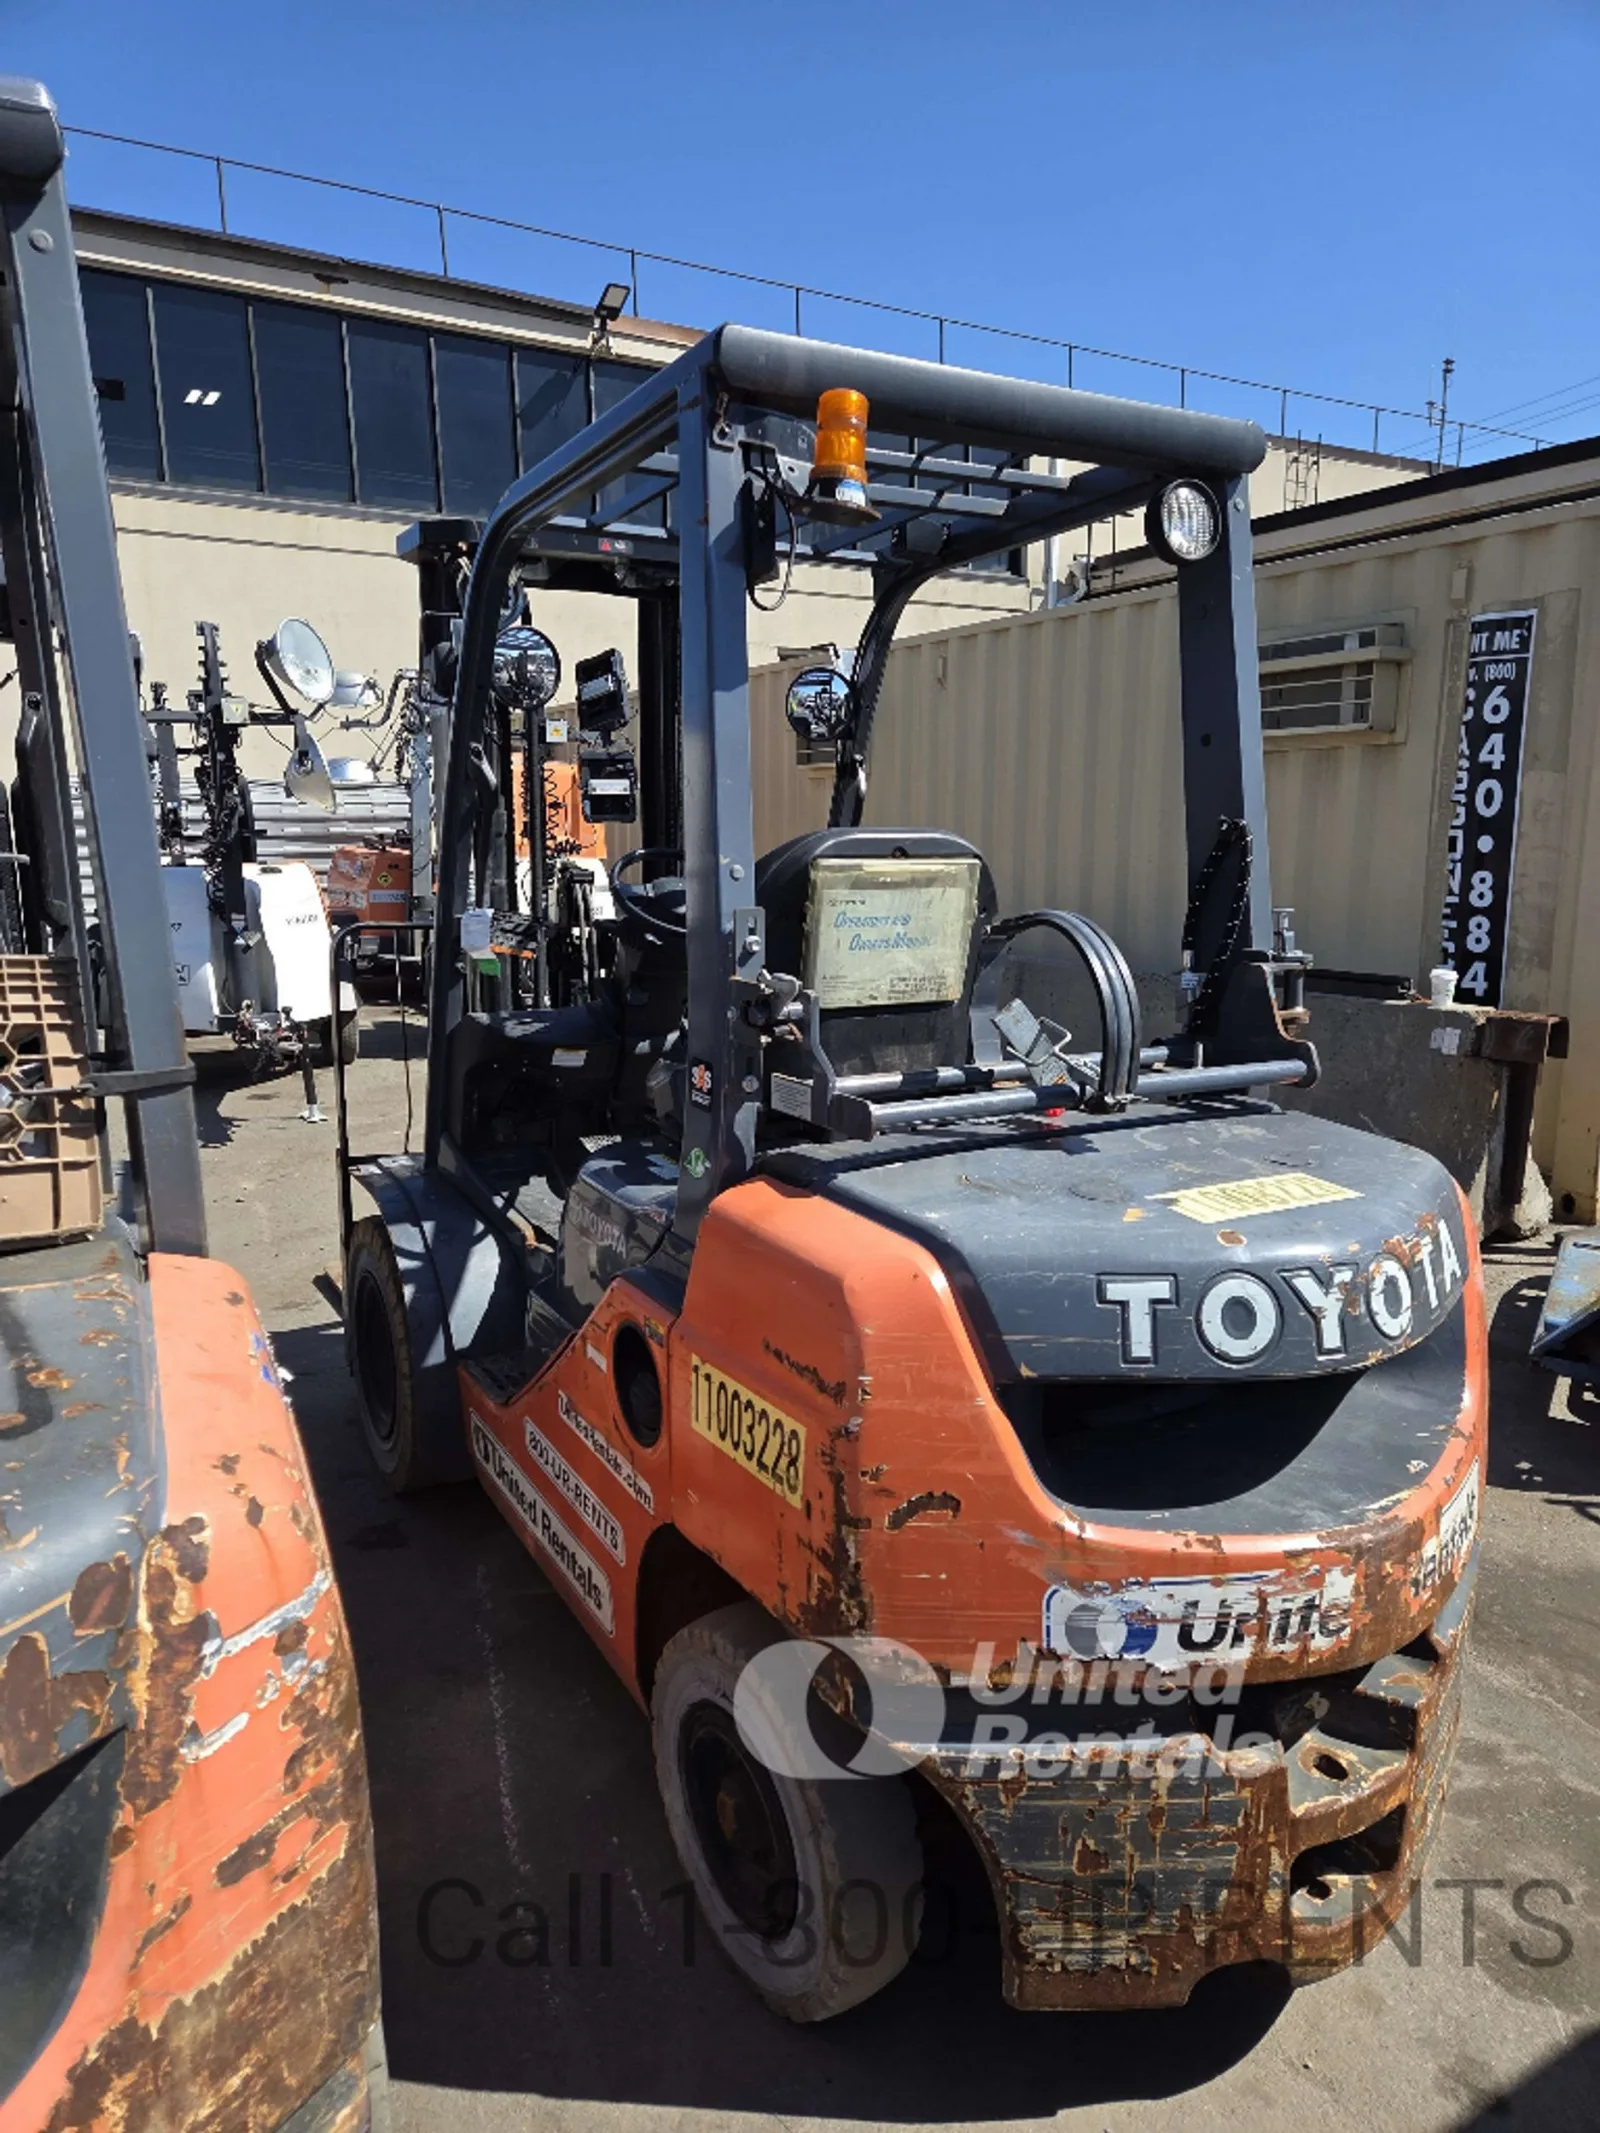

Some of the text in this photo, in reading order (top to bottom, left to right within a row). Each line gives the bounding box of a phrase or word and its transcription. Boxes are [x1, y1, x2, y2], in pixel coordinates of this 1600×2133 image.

[583, 1208, 628, 1260] TOYOTA
[1098, 1219, 1463, 1364] TOYOTA
[692, 1364, 800, 1494] 11003228
[492, 1442, 603, 1610] United Rentals
[1177, 1595, 1350, 1653] Unite
